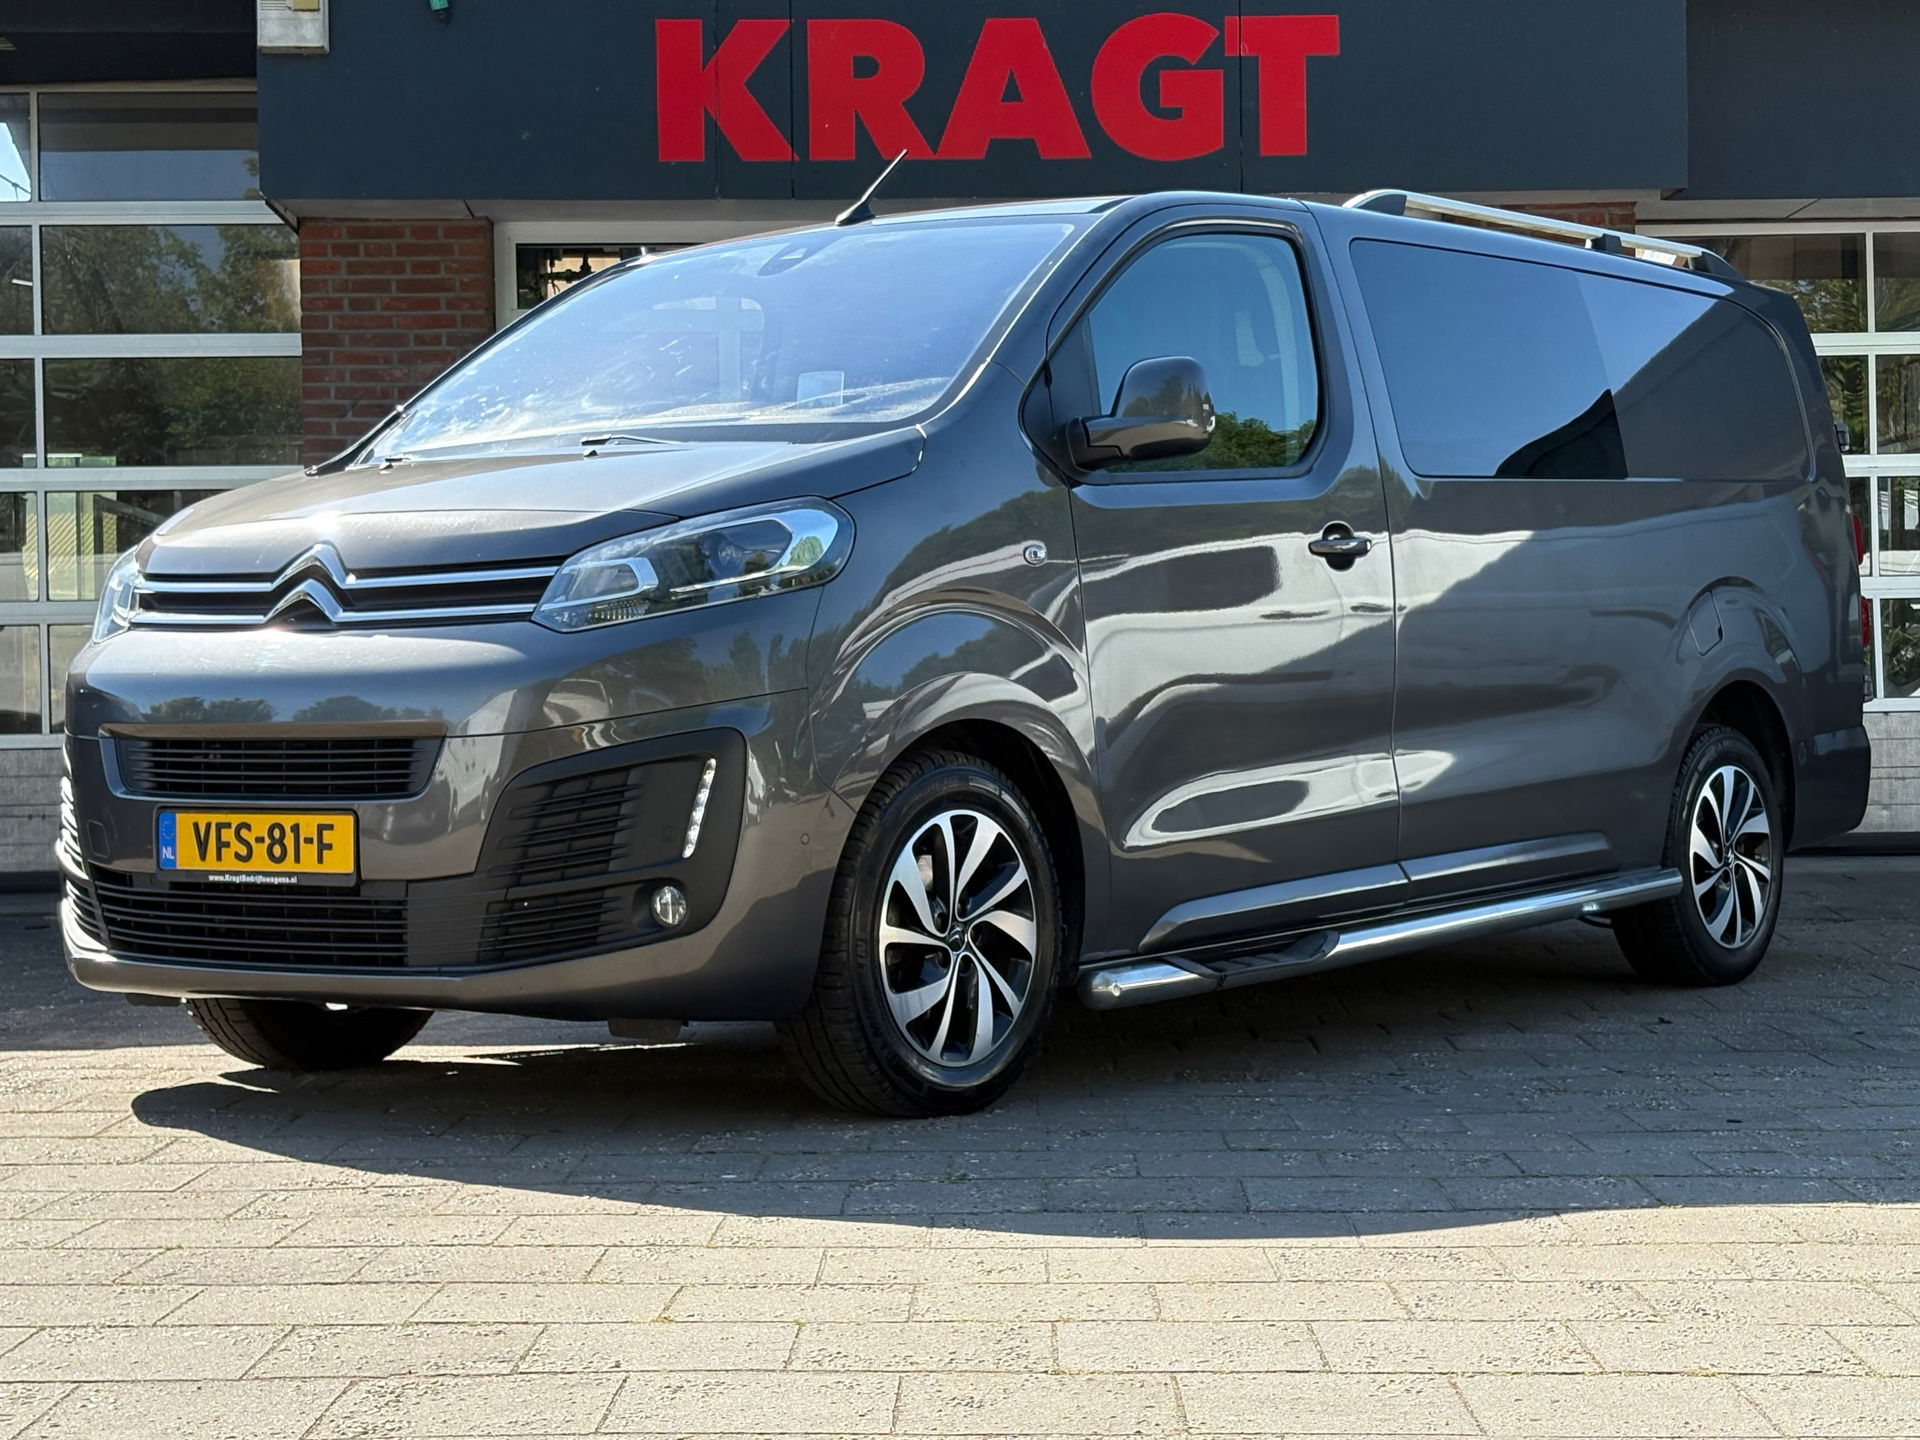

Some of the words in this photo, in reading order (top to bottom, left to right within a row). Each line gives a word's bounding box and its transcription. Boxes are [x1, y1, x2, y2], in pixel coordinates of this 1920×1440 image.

[655, 13, 1340, 161] KRAGT
[162, 846, 175, 859] NL
[192, 821, 335, 865] VFS-81-F
